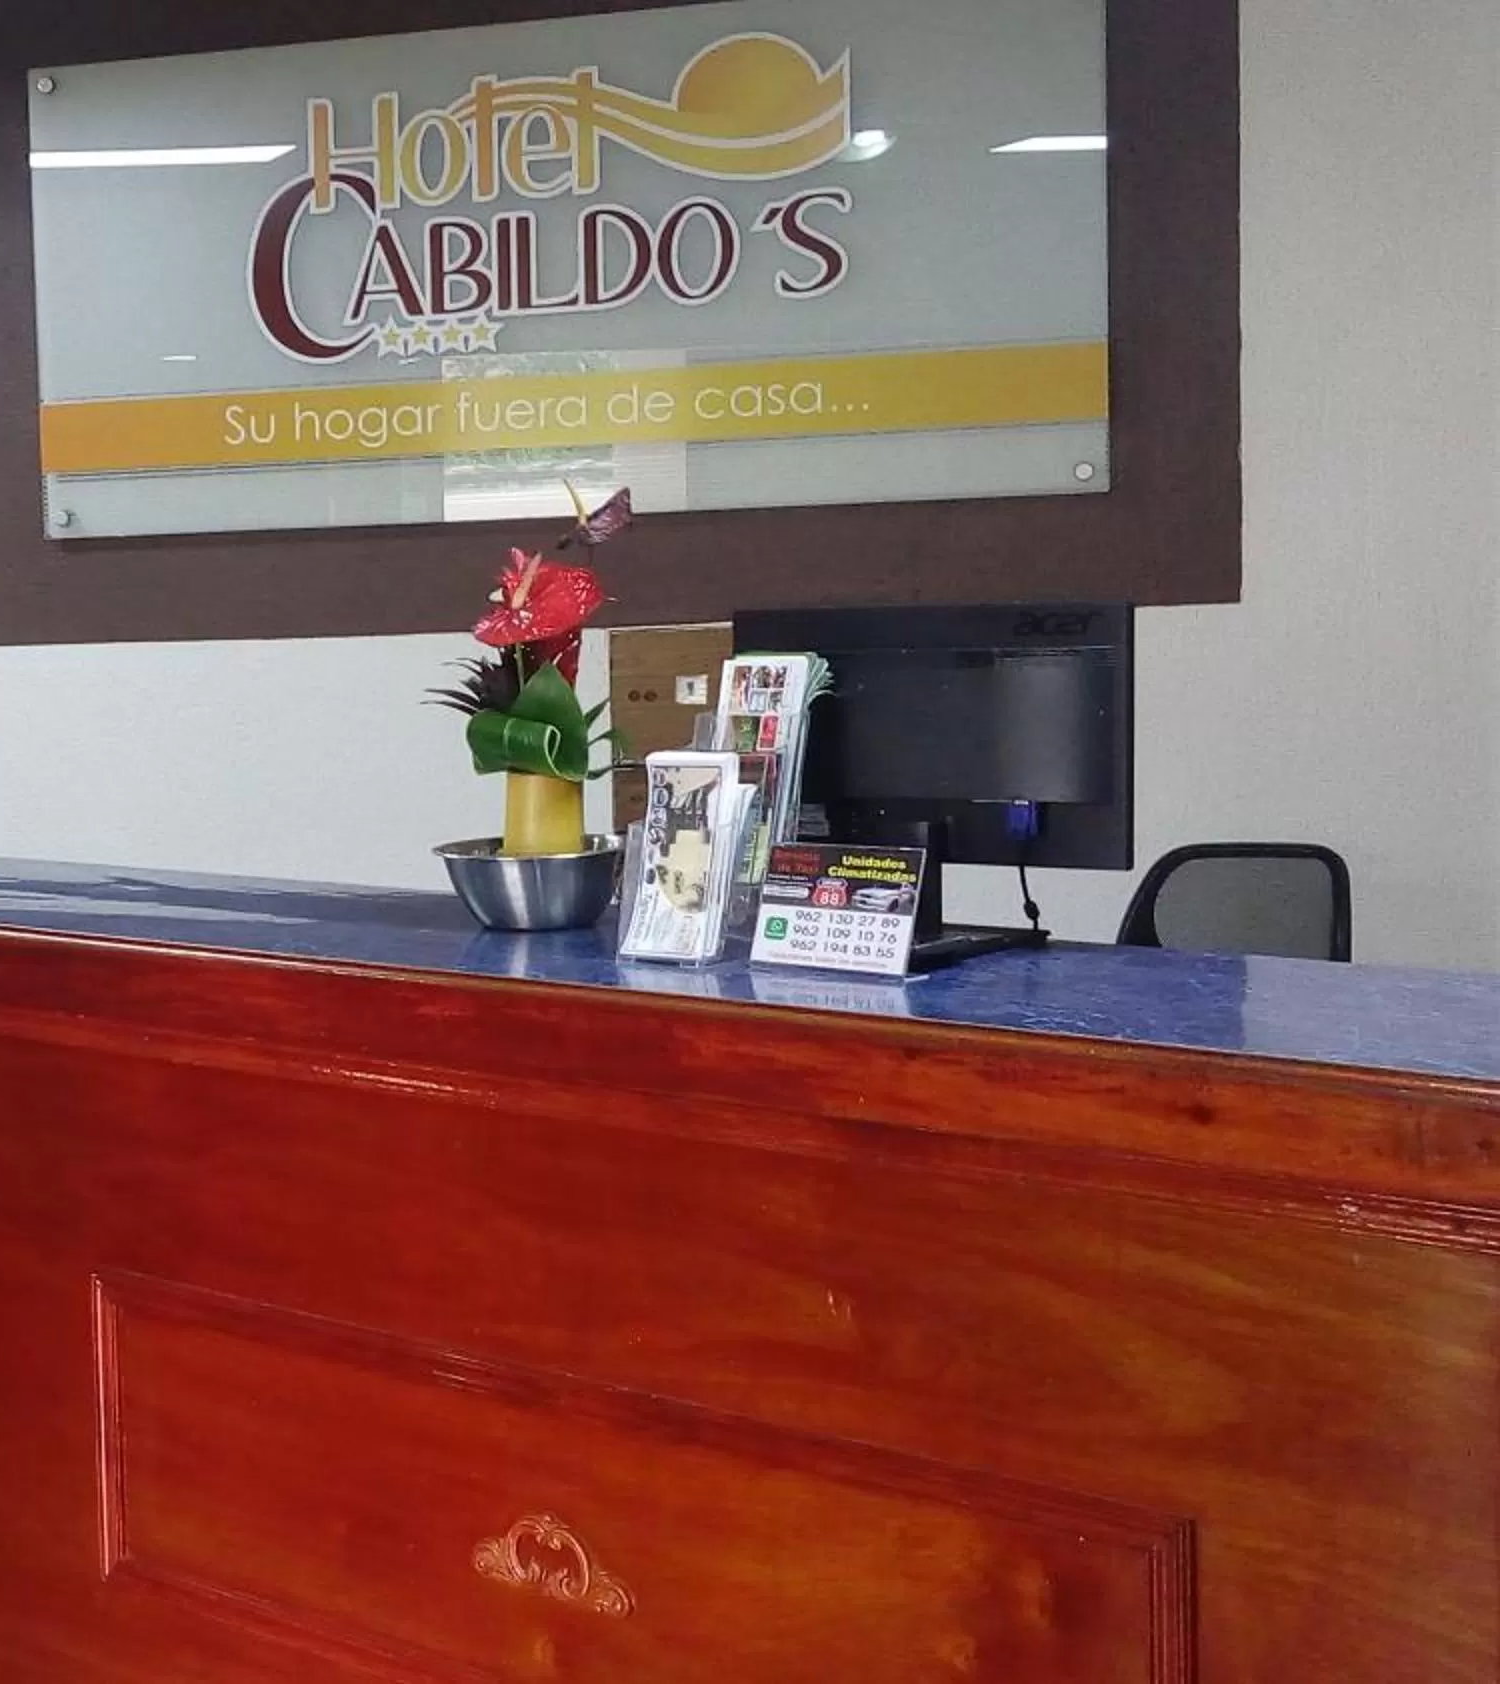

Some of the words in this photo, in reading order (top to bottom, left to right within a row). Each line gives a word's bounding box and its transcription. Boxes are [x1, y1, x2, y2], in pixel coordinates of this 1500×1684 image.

[309, 70, 599, 211] Hotel
[223, 404, 276, 445] Su
[293, 401, 442, 448] hogar
[455, 391, 588, 433] fuera
[606, 383, 677, 425] de
[694, 381, 870, 420] casa...
[1013, 611, 1102, 636] acer
[841, 855, 907, 869] Unidades
[827, 866, 917, 882] Climatizadas
[795, 910, 821, 923] 962
[828, 913, 854, 925] 130
[858, 916, 876, 927] 27
[881, 917, 900, 929] 89
[792, 924, 819, 937] 962
[826, 927, 851, 939] 109
[858, 930, 875, 942] 10
[879, 932, 897, 944] 76
[789, 939, 817, 951] 962
